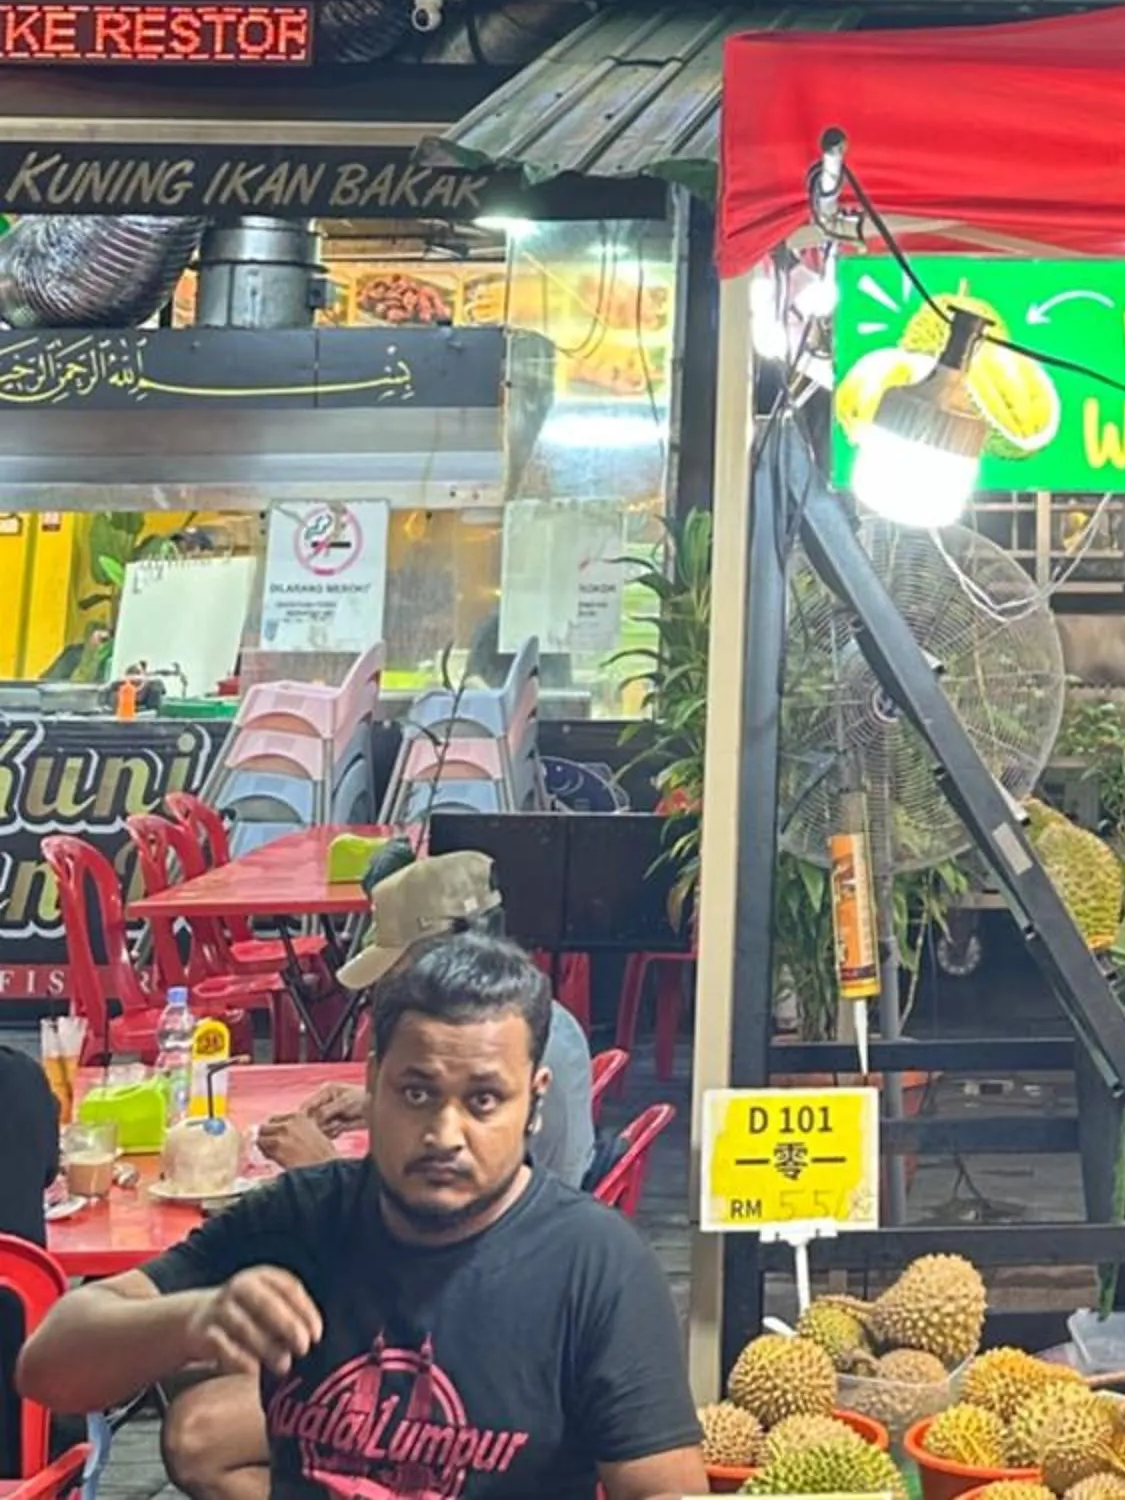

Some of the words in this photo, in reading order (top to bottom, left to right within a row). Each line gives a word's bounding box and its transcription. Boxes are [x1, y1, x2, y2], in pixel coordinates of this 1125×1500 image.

[4, 11, 78, 51] KE
[5, 152, 194, 204] KUNING
[204, 160, 327, 206] IKAN
[749, 1107, 769, 1135] D
[779, 1106, 833, 1134] 101
[730, 1199, 762, 1219] RM
[269, 1376, 372, 1452] Kuala
[363, 1393, 530, 1479] Lumpur
